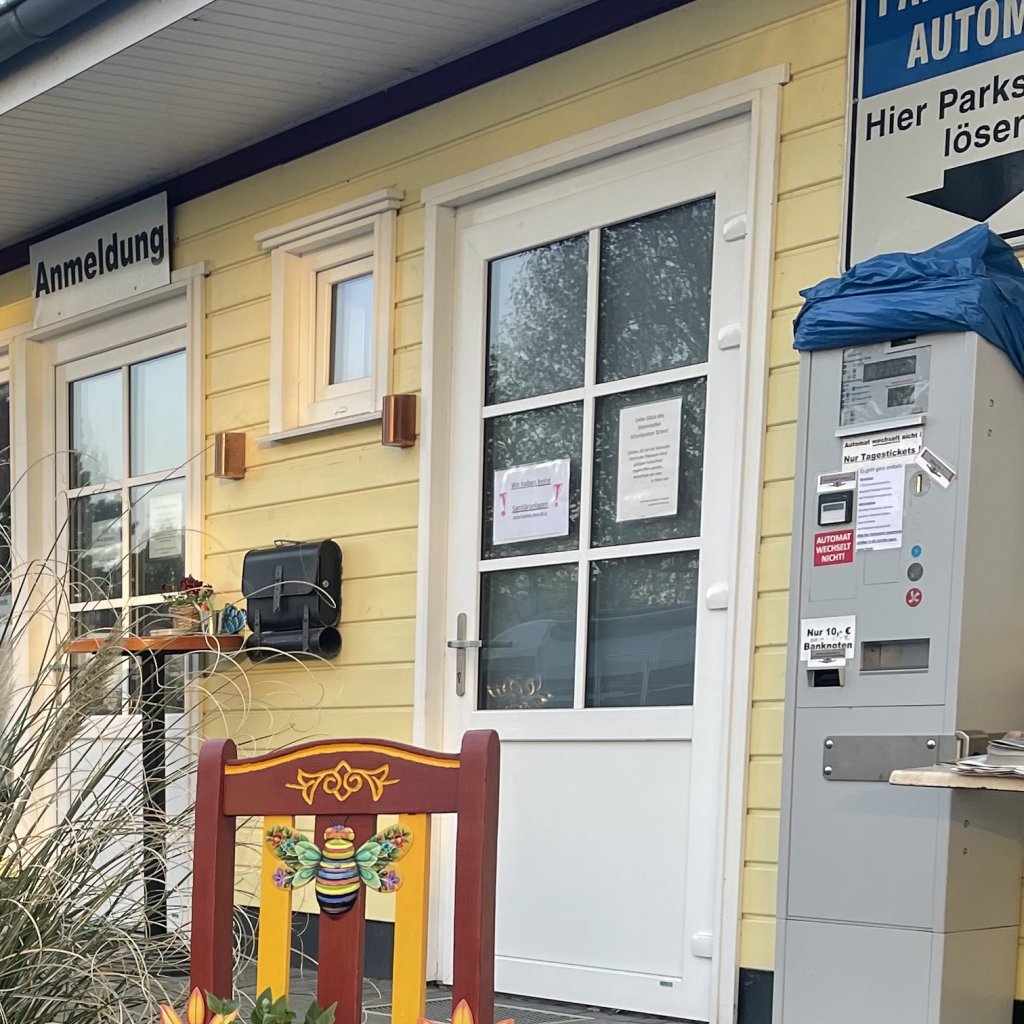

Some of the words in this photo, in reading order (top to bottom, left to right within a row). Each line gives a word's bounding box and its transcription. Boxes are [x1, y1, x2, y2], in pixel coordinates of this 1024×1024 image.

[866, 102, 928, 141] Hier
[939, 75, 1024, 120] Parks
[35, 224, 165, 299] Anmeldung
[844, 440, 870, 448] Automat
[844, 454, 858, 463] Nur
[861, 447, 916, 461] Tagestickets
[816, 533, 852, 544] AUTOMAT
[815, 543, 851, 554] WECHSELT
[845, 626, 851, 635] €
[804, 642, 853, 650] Banknoten
